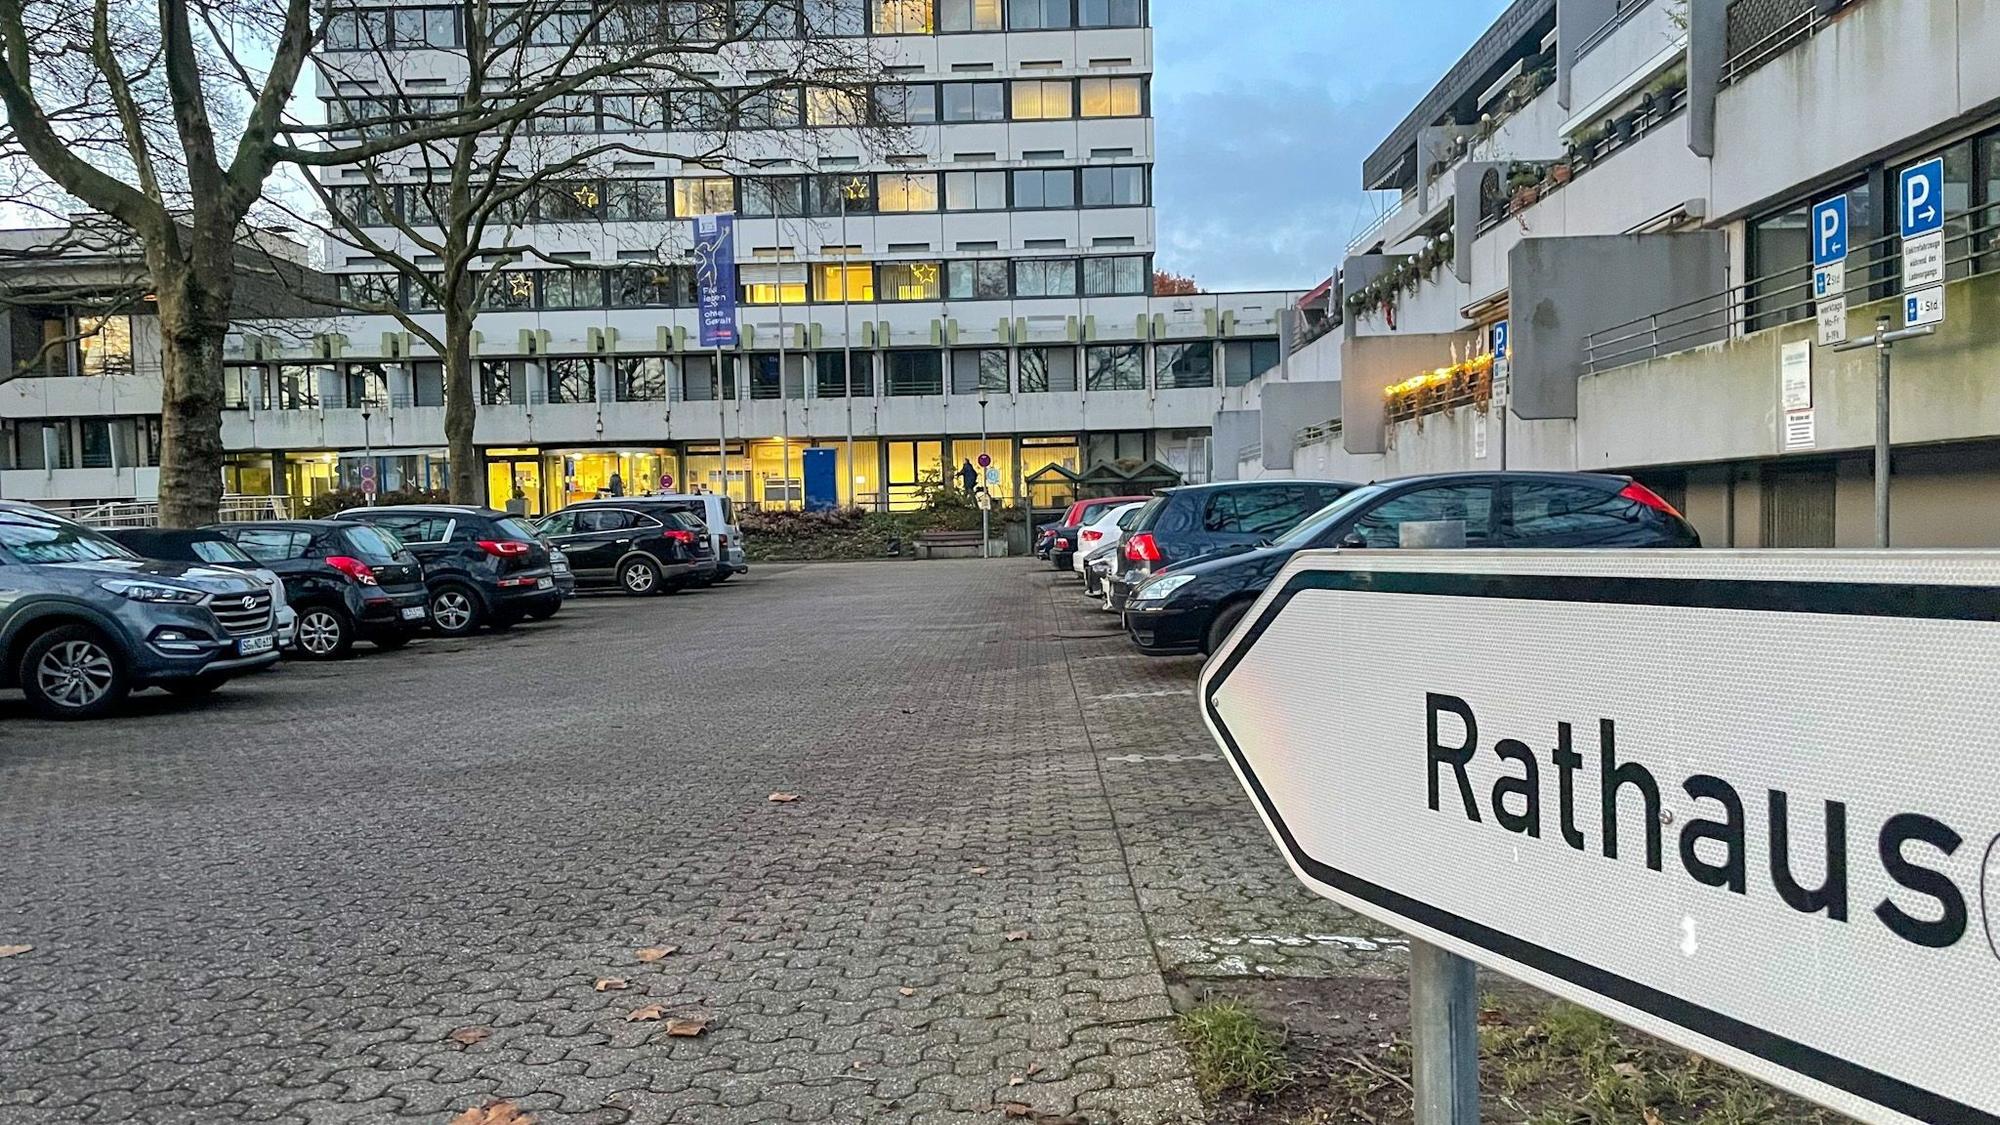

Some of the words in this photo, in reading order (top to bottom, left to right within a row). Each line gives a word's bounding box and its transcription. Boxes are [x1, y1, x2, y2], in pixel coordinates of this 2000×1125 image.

[1907, 174, 1929, 227] P
[1821, 208, 1839, 256] P
[1496, 326, 1504, 355] P
[1425, 691, 1968, 949] Rathaus
